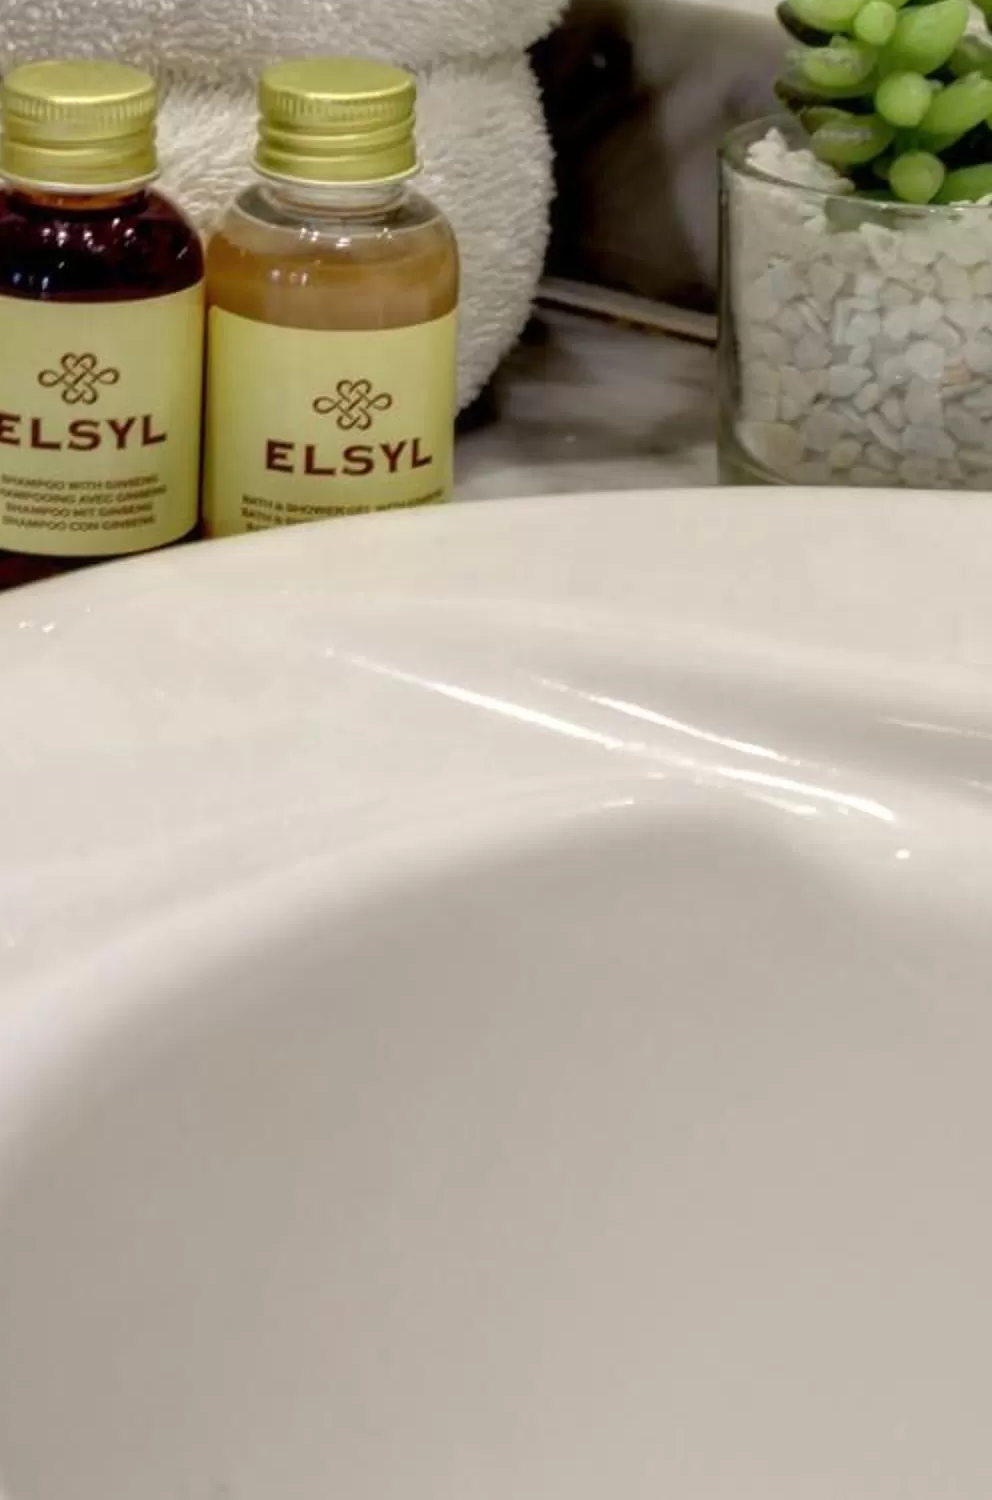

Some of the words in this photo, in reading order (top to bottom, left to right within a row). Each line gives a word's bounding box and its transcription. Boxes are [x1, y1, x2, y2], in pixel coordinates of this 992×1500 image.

[265, 436, 433, 477] ELSYL
[1, 473, 65, 490] SHAMPOO
[68, 480, 102, 491] WITH
[79, 494, 113, 505] AVEC
[241, 493, 273, 509] BATH
[286, 502, 345, 517] SHOWER
[5, 501, 70, 517] SHAMPOO
[73, 508, 95, 517] MIT
[241, 507, 272, 521] BATH
[2, 514, 66, 532] SHAMPOO
[69, 521, 99, 532] CON
